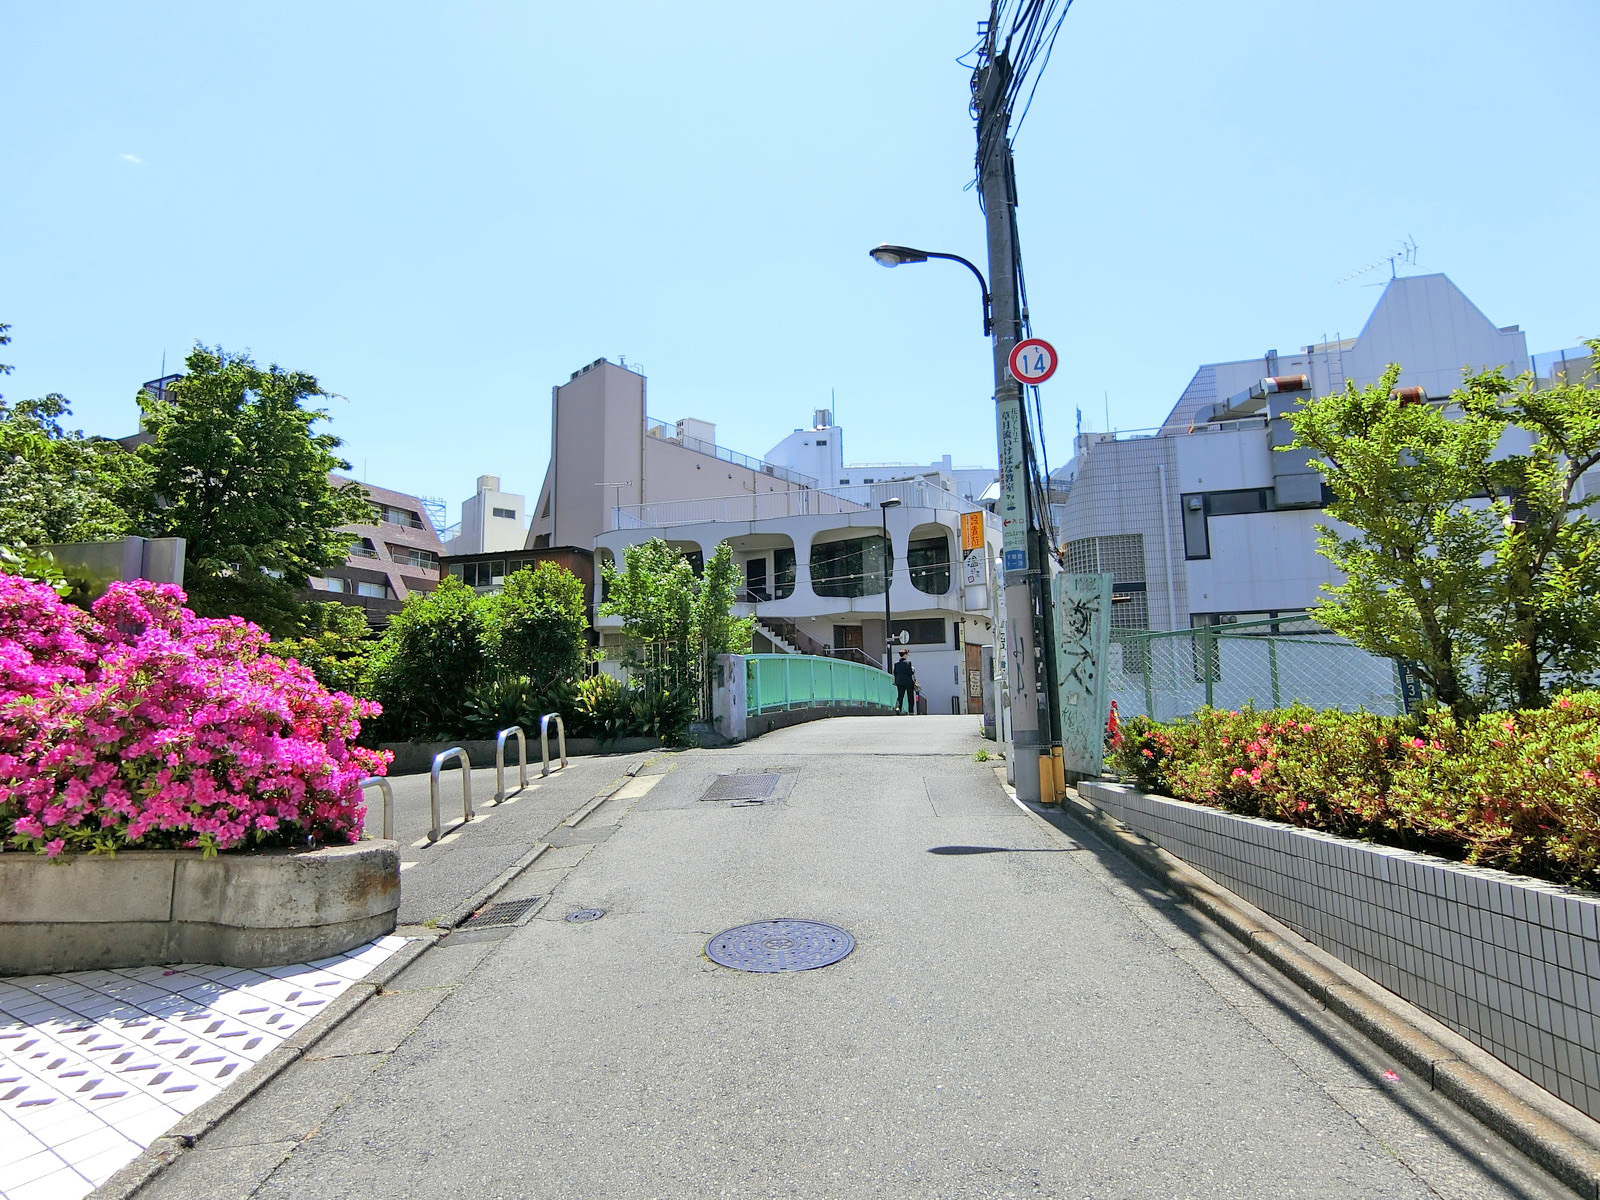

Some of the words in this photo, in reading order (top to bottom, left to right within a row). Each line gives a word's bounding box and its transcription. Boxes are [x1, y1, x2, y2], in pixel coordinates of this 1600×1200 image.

[1023, 353, 1046, 374] 14
[1011, 407, 1019, 443] 花のアトリエ
[1002, 411, 1014, 492] 草月流いけばな教室
